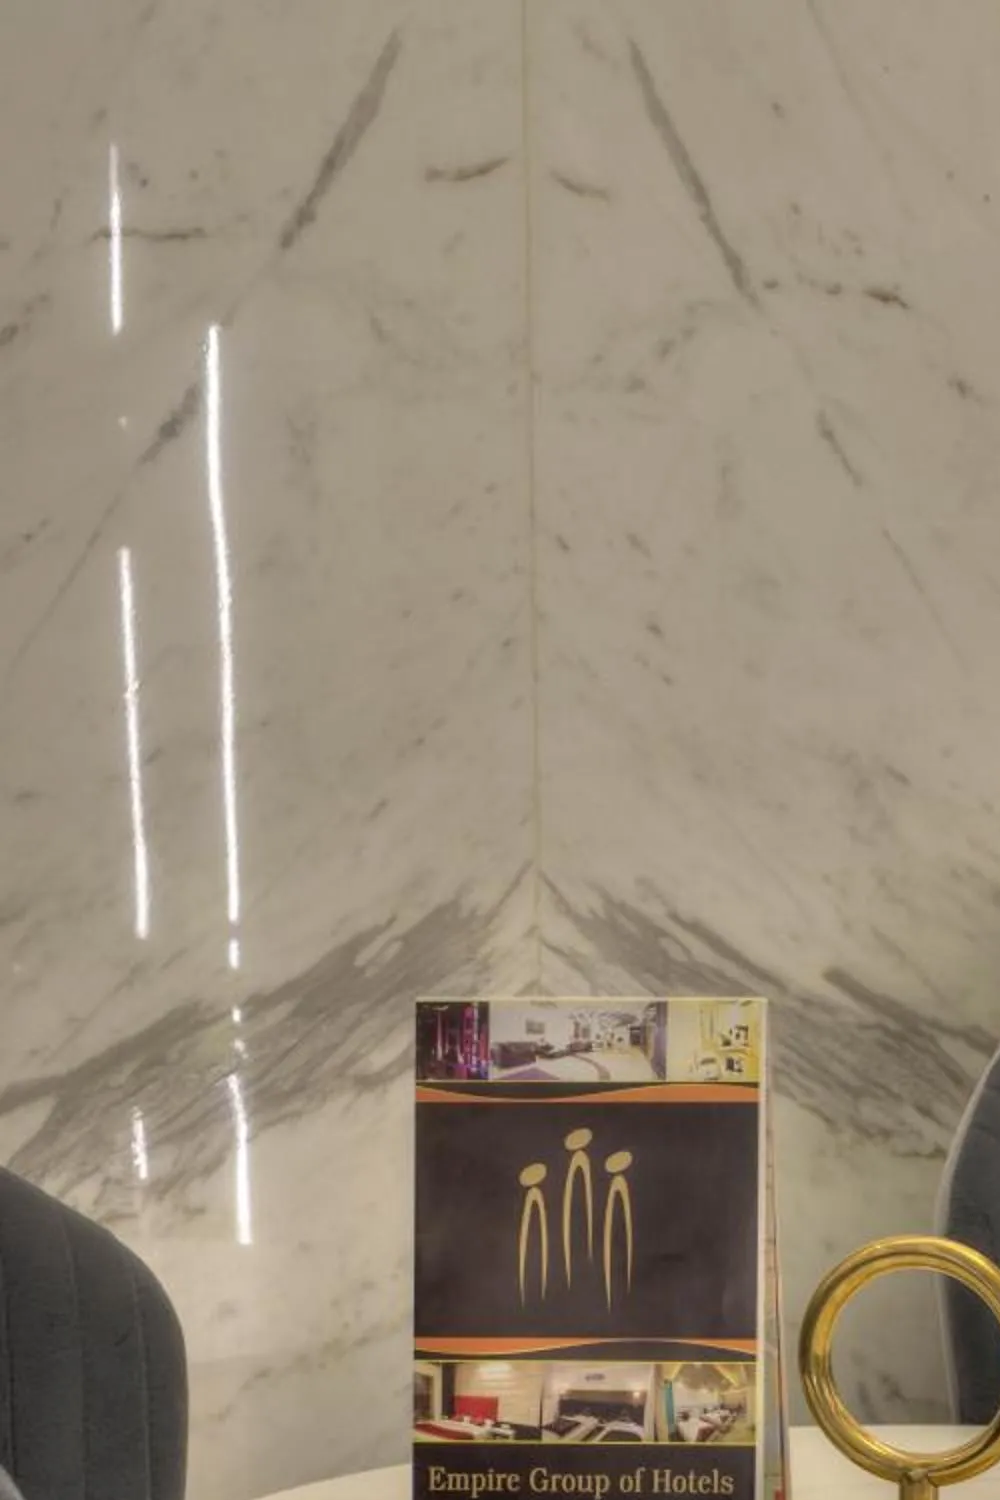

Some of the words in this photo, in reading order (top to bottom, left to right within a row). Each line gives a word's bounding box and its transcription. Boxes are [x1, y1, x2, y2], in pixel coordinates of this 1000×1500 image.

[428, 1466, 521, 1499] Empire
[529, 1467, 611, 1500] Group
[619, 1467, 644, 1494] of
[652, 1468, 735, 1495] Hotels
